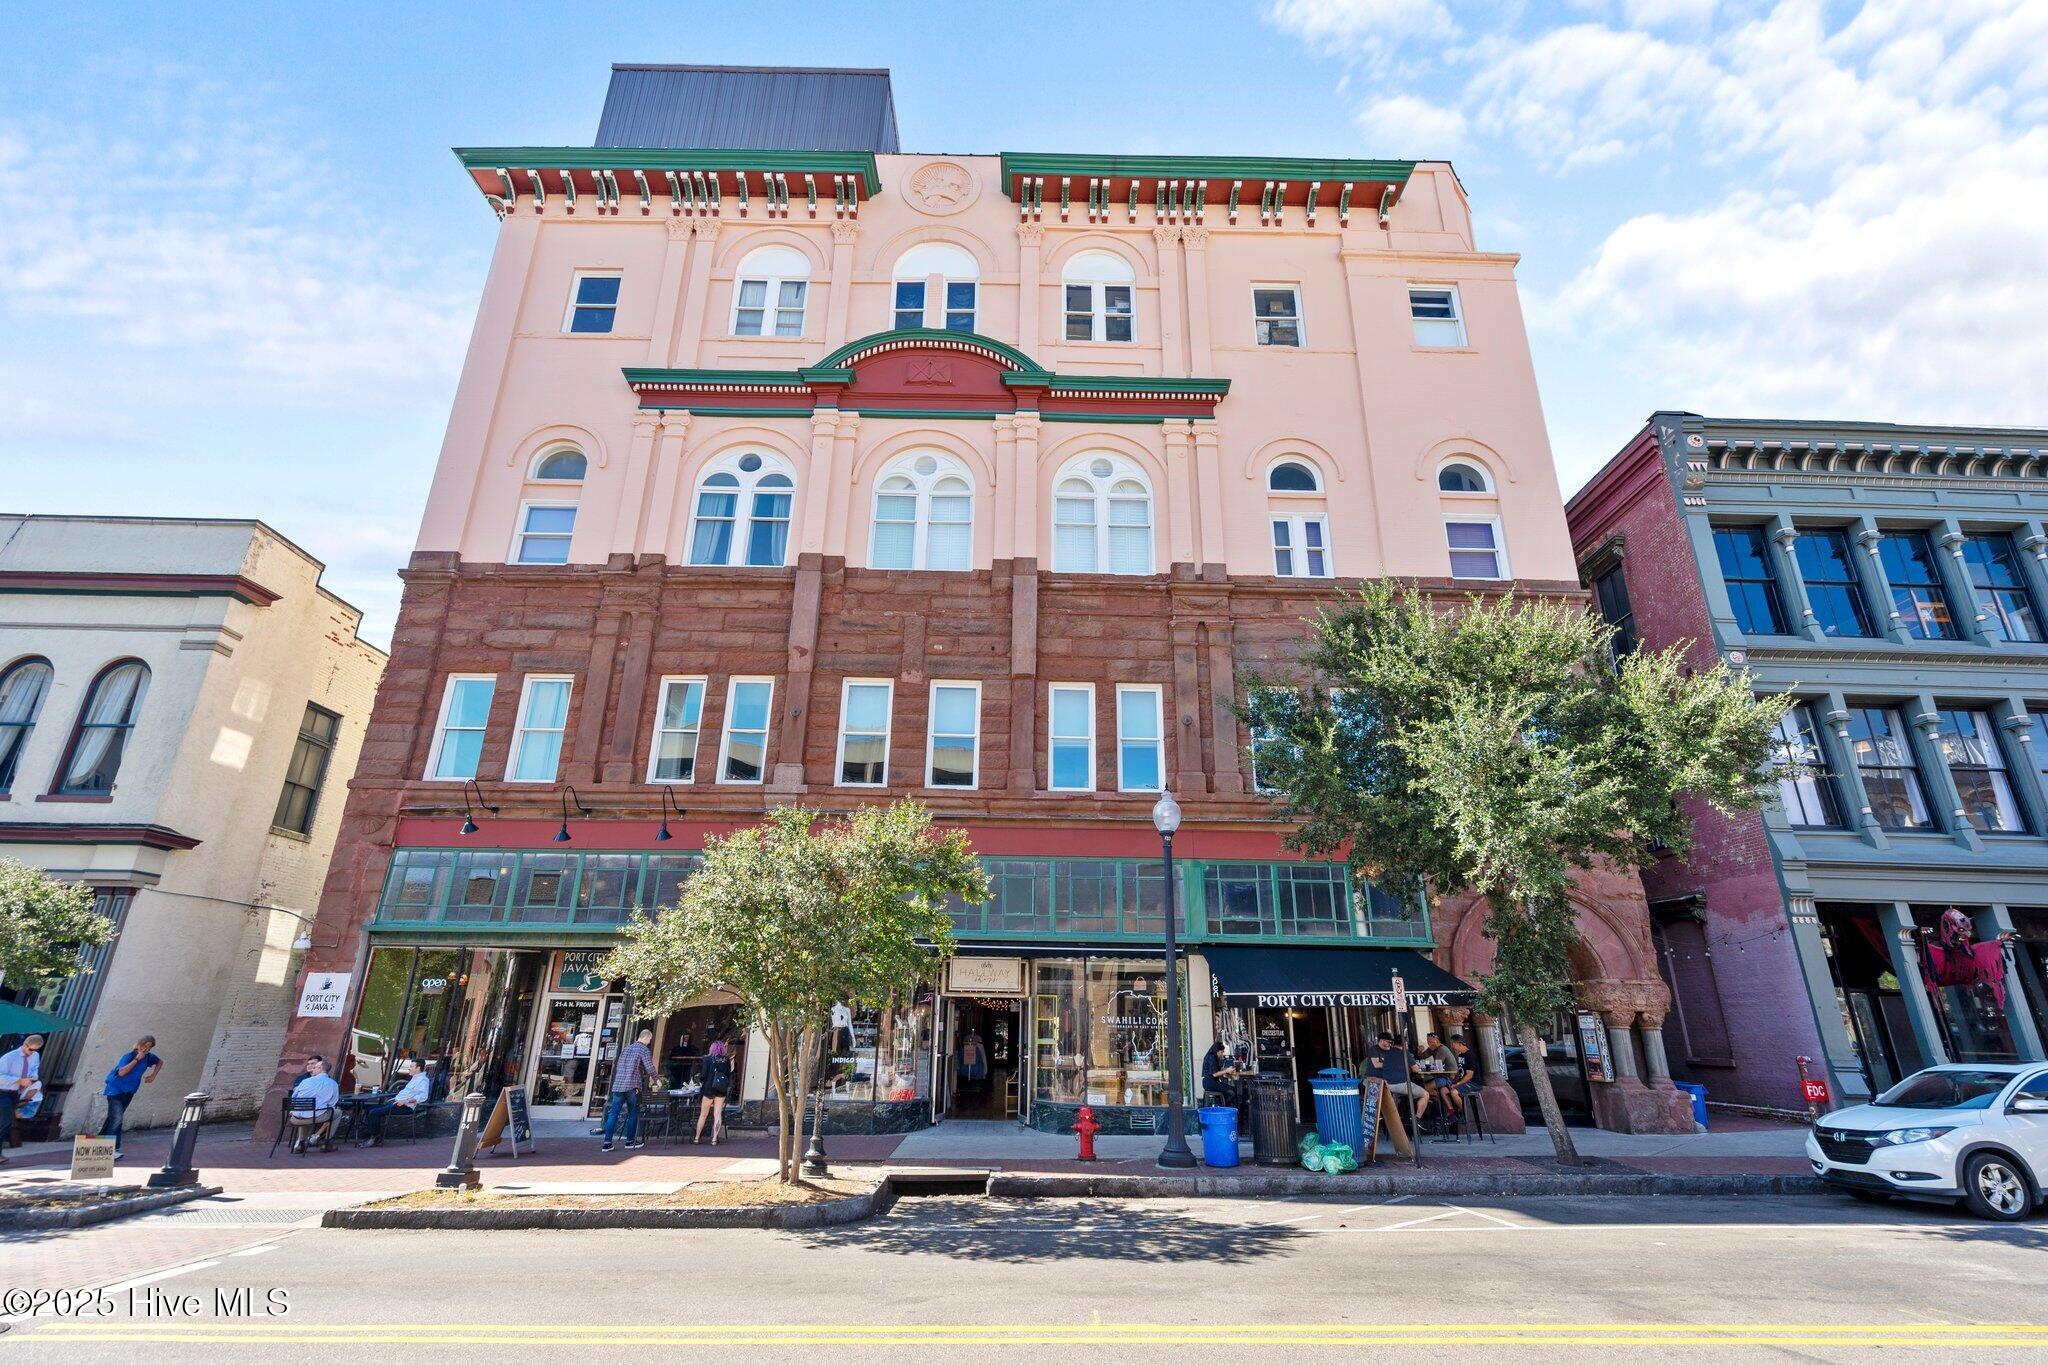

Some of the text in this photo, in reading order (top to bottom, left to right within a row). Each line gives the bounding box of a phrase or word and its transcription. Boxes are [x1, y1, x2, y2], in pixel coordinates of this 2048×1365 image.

[564, 952, 587, 962] PORT
[562, 963, 590, 973] JAVA
[305, 994, 341, 1003] PORT CITY
[1257, 993, 1449, 1008] PORT CITY CHEESETEAK
[310, 1003, 329, 1012] JAVA
[1101, 1015, 1142, 1025] SWAHILI
[888, 1088, 915, 1102] OPEN
[1806, 1085, 1825, 1097] FDC
[76, 1145, 114, 1156] NOW HIRING
